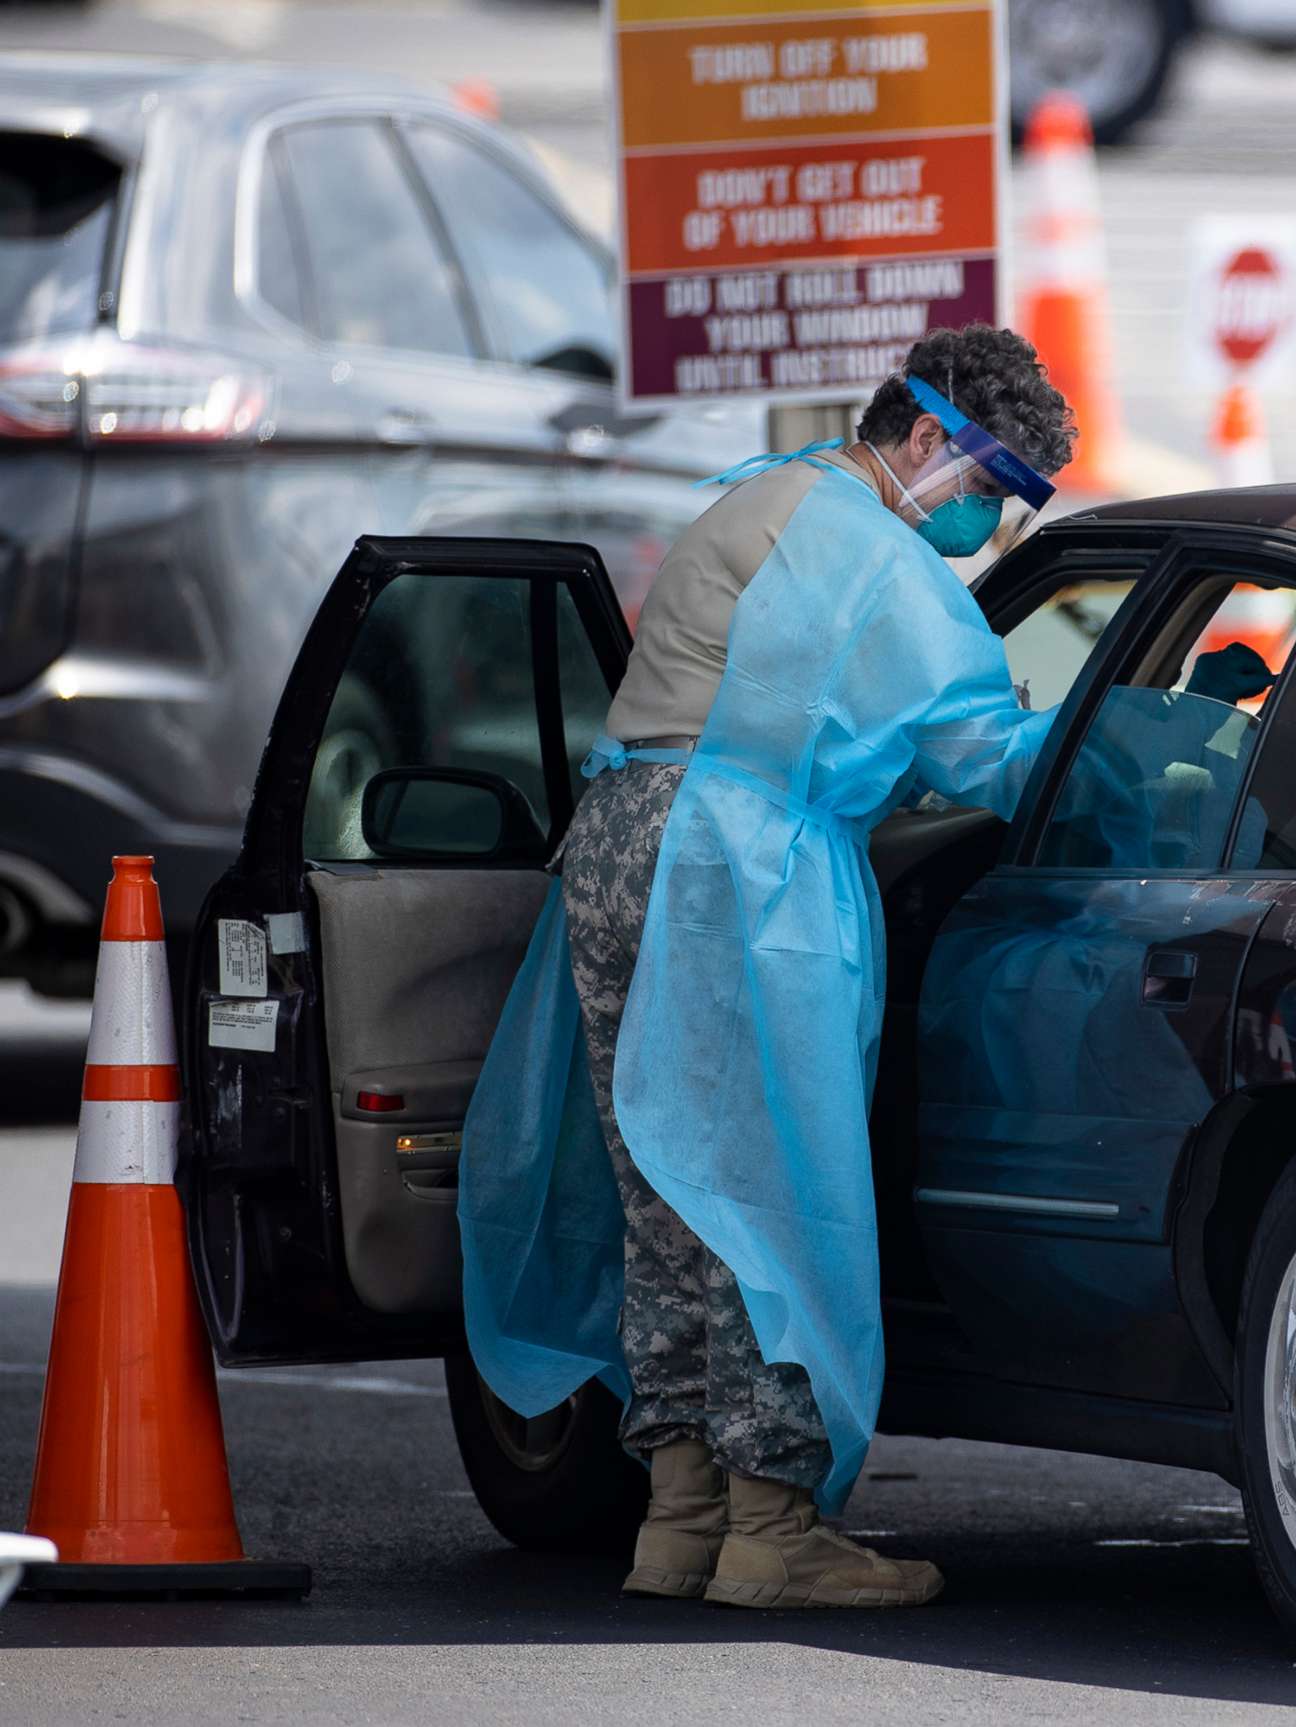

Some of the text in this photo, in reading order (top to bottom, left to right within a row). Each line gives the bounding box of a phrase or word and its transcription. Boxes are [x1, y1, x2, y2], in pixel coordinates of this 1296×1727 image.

[692, 35, 925, 81] TURN OFF YOUR
[701, 159, 923, 204] DON'T GET OUT
[686, 198, 941, 248] OF YOUR VEHICLE
[668, 261, 962, 314] DO NOT ROLL DOWN
[707, 305, 926, 348] YOUR WINDOW
[678, 356, 766, 389] UNTIL
